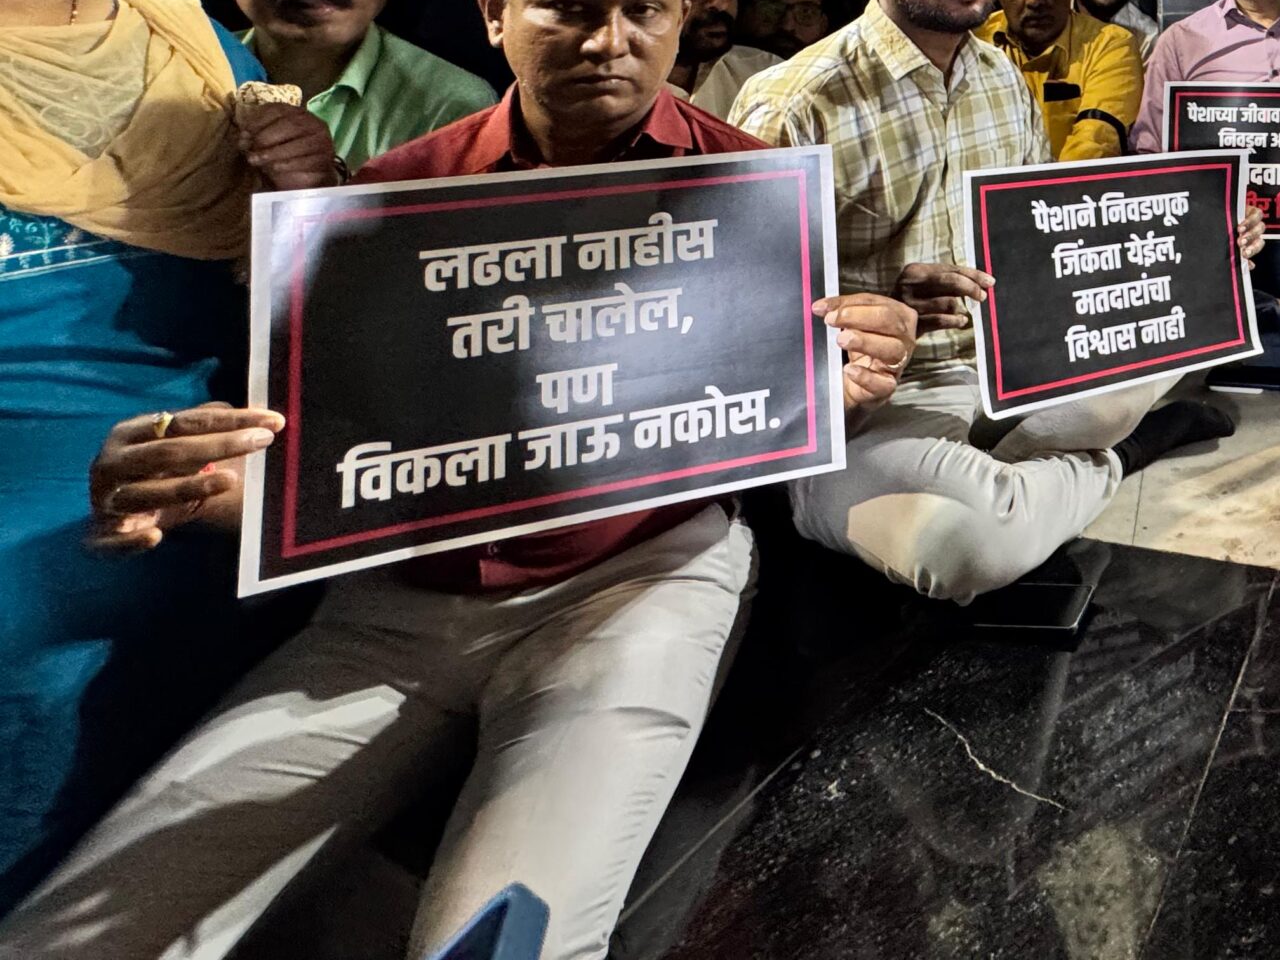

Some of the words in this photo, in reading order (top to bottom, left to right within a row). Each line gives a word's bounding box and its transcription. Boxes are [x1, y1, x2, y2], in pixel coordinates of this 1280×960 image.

[1187, 102, 1238, 123] पैशाच्या
[1218, 127, 1269, 154] निवडून
[1031, 195, 1098, 234] पैशाने
[1098, 191, 1190, 226] निवडणूक
[419, 235, 566, 292] लढला
[572, 211, 718, 271] नाहीस
[1051, 239, 1122, 279] जिंकता
[1123, 231, 1182, 268] येईल,
[1072, 272, 1172, 316] मतदारांचा
[446, 295, 534, 359] तरी
[542, 284, 695, 344] चालेल,
[1064, 324, 1136, 362] विश्वास
[1137, 306, 1186, 343] नाही
[535, 362, 618, 414] पण
[336, 441, 507, 509] विकला
[517, 416, 622, 474] जाऊ
[628, 386, 782, 449] नकोस.
